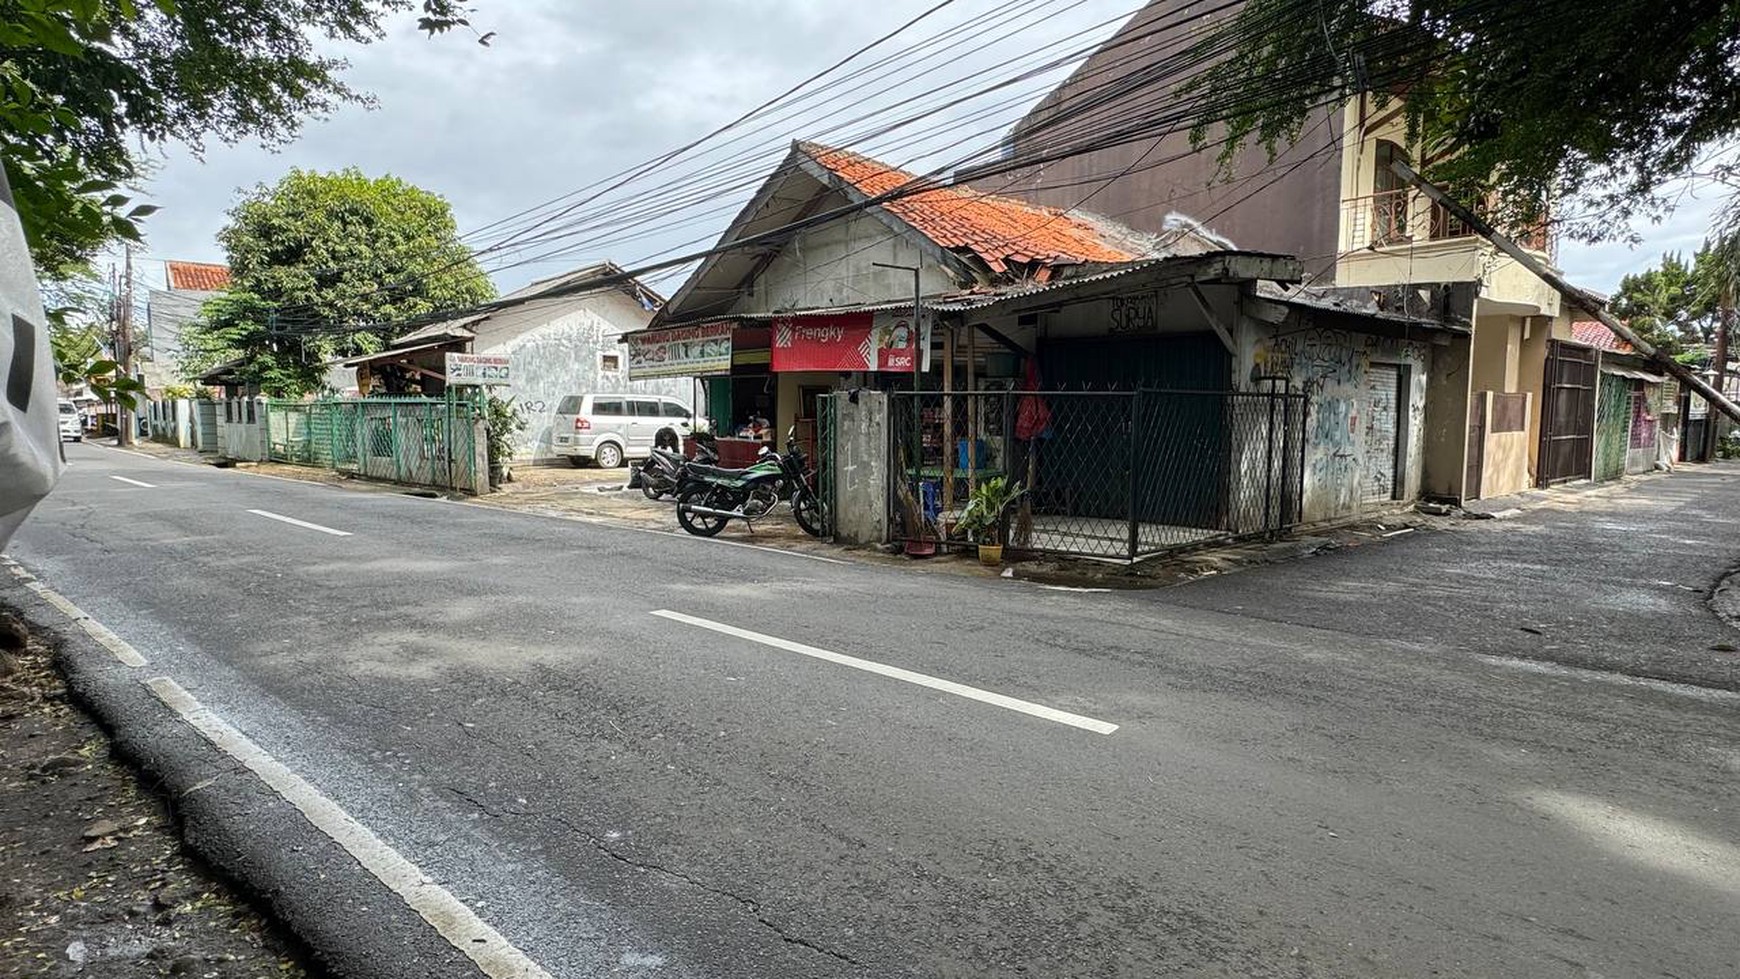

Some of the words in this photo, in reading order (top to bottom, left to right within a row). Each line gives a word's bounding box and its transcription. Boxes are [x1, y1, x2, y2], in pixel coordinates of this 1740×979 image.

[1111, 305, 1154, 329] SURYA
[794, 325, 842, 345] Frengky
[895, 356, 912, 367] SRC
